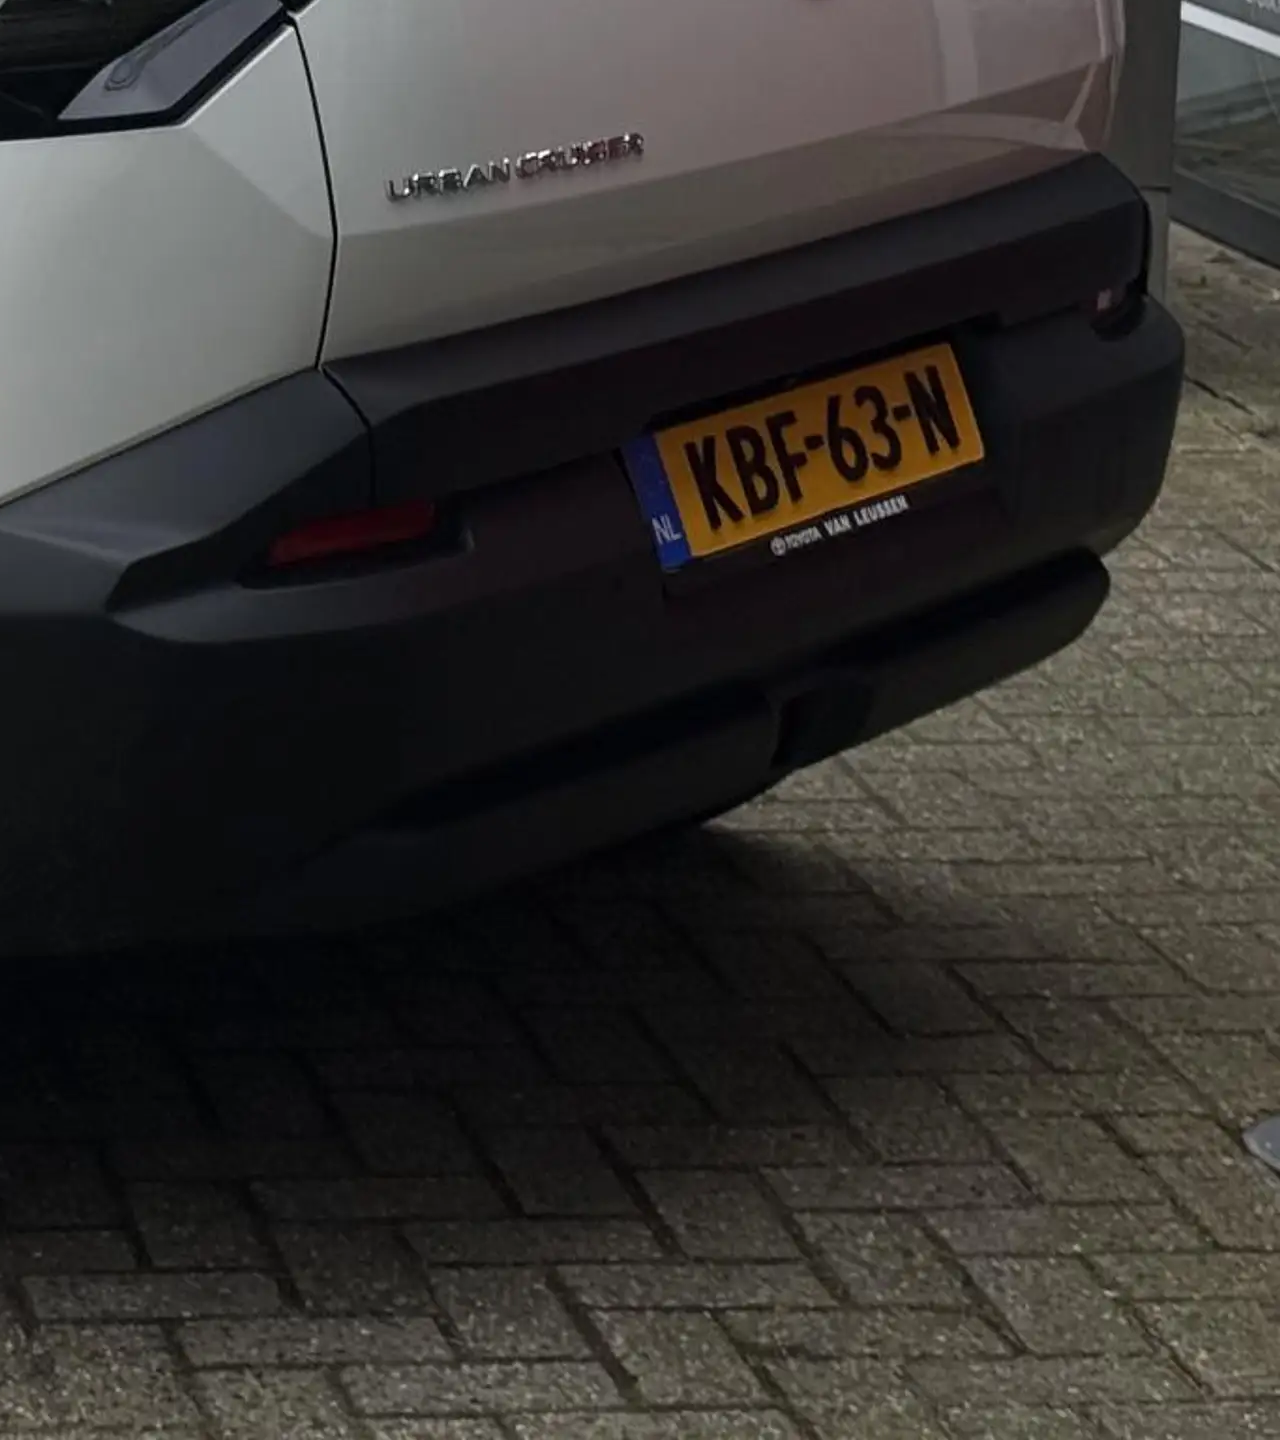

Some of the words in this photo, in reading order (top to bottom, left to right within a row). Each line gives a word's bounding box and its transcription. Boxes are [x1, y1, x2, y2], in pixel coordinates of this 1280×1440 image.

[386, 157, 511, 202] URBAN
[515, 132, 645, 179] CRUISER
[683, 363, 963, 532] KBF-63-N
[650, 512, 682, 547] NL
[824, 513, 852, 537] VAN
[853, 493, 910, 527] LEUSSEN
